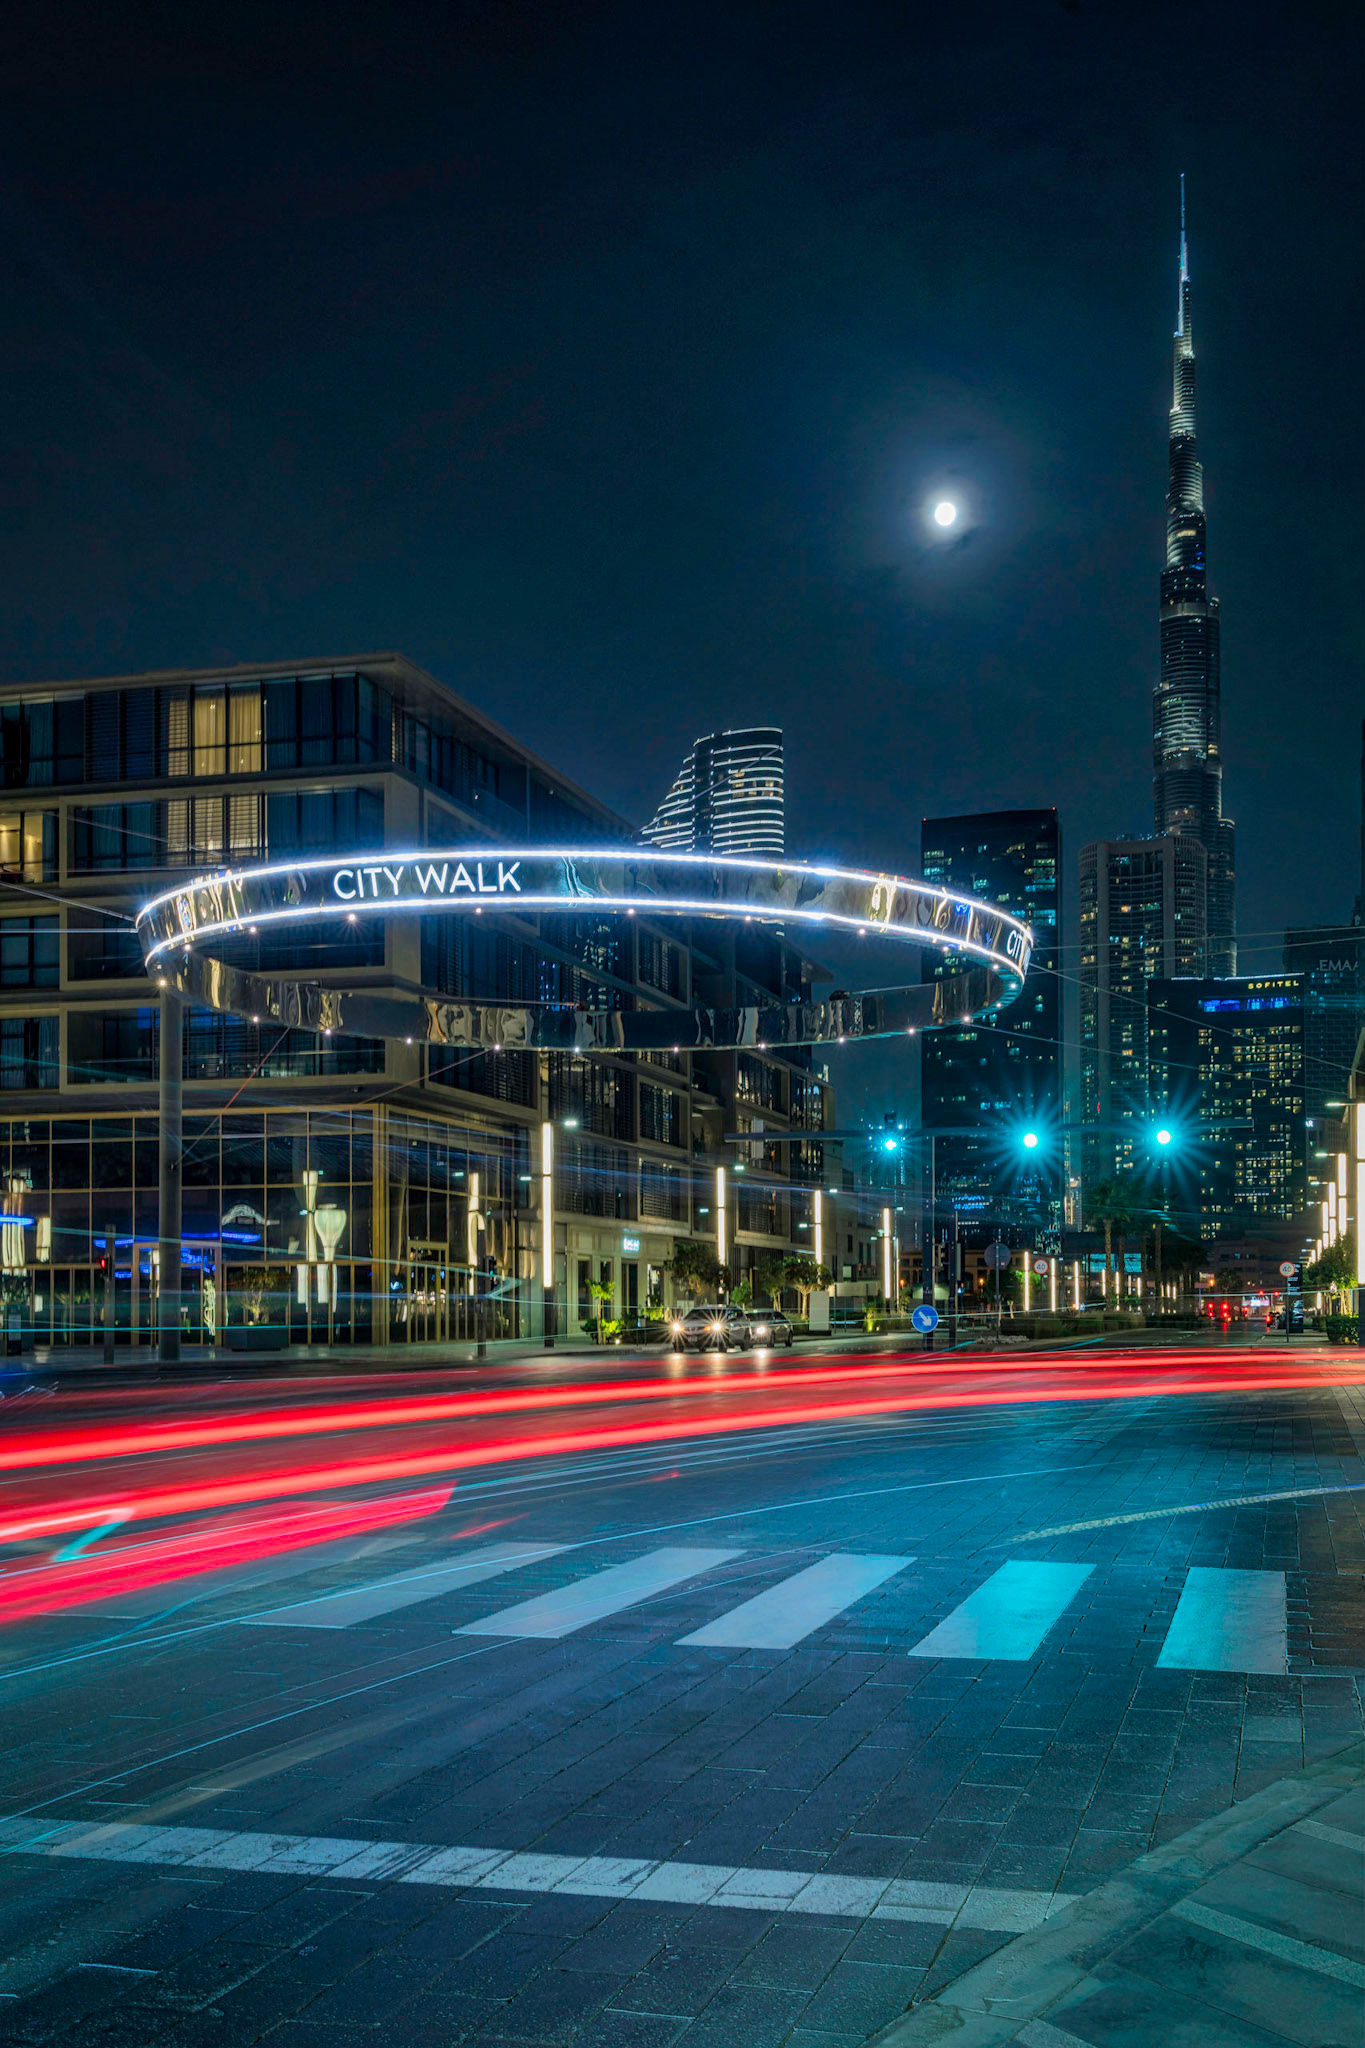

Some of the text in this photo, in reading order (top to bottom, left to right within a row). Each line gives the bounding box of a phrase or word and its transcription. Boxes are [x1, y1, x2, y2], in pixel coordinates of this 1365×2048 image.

[333, 862, 521, 899] CITY WALK
[1248, 980, 1299, 989] SOFITEL
